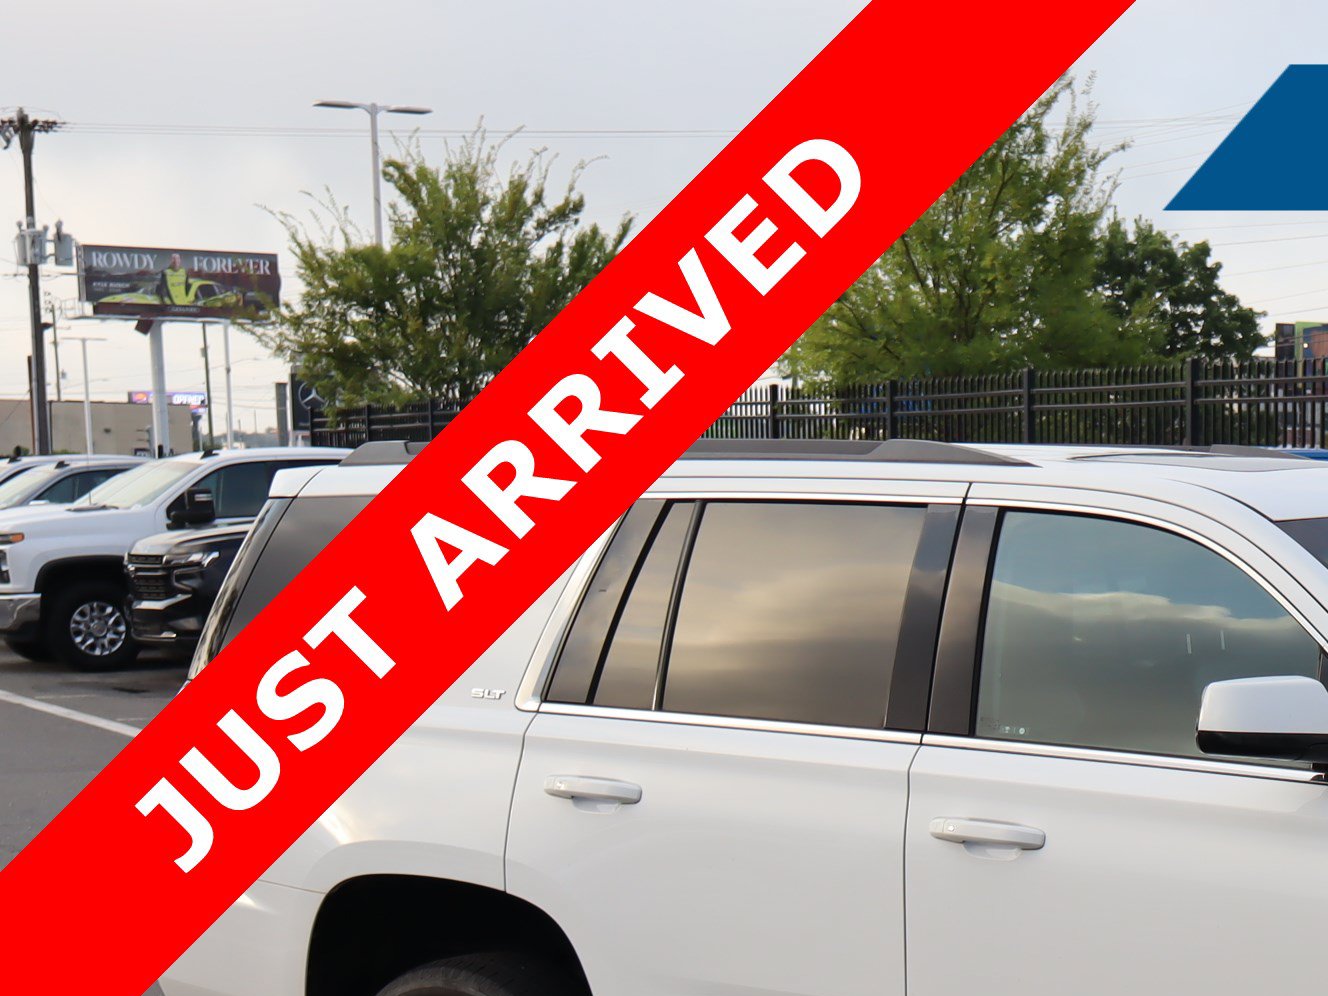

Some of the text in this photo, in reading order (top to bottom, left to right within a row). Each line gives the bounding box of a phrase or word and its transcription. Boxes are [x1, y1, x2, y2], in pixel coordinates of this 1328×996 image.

[91, 251, 271, 275] ROWDY FOREVER
[471, 687, 507, 700] SLT
